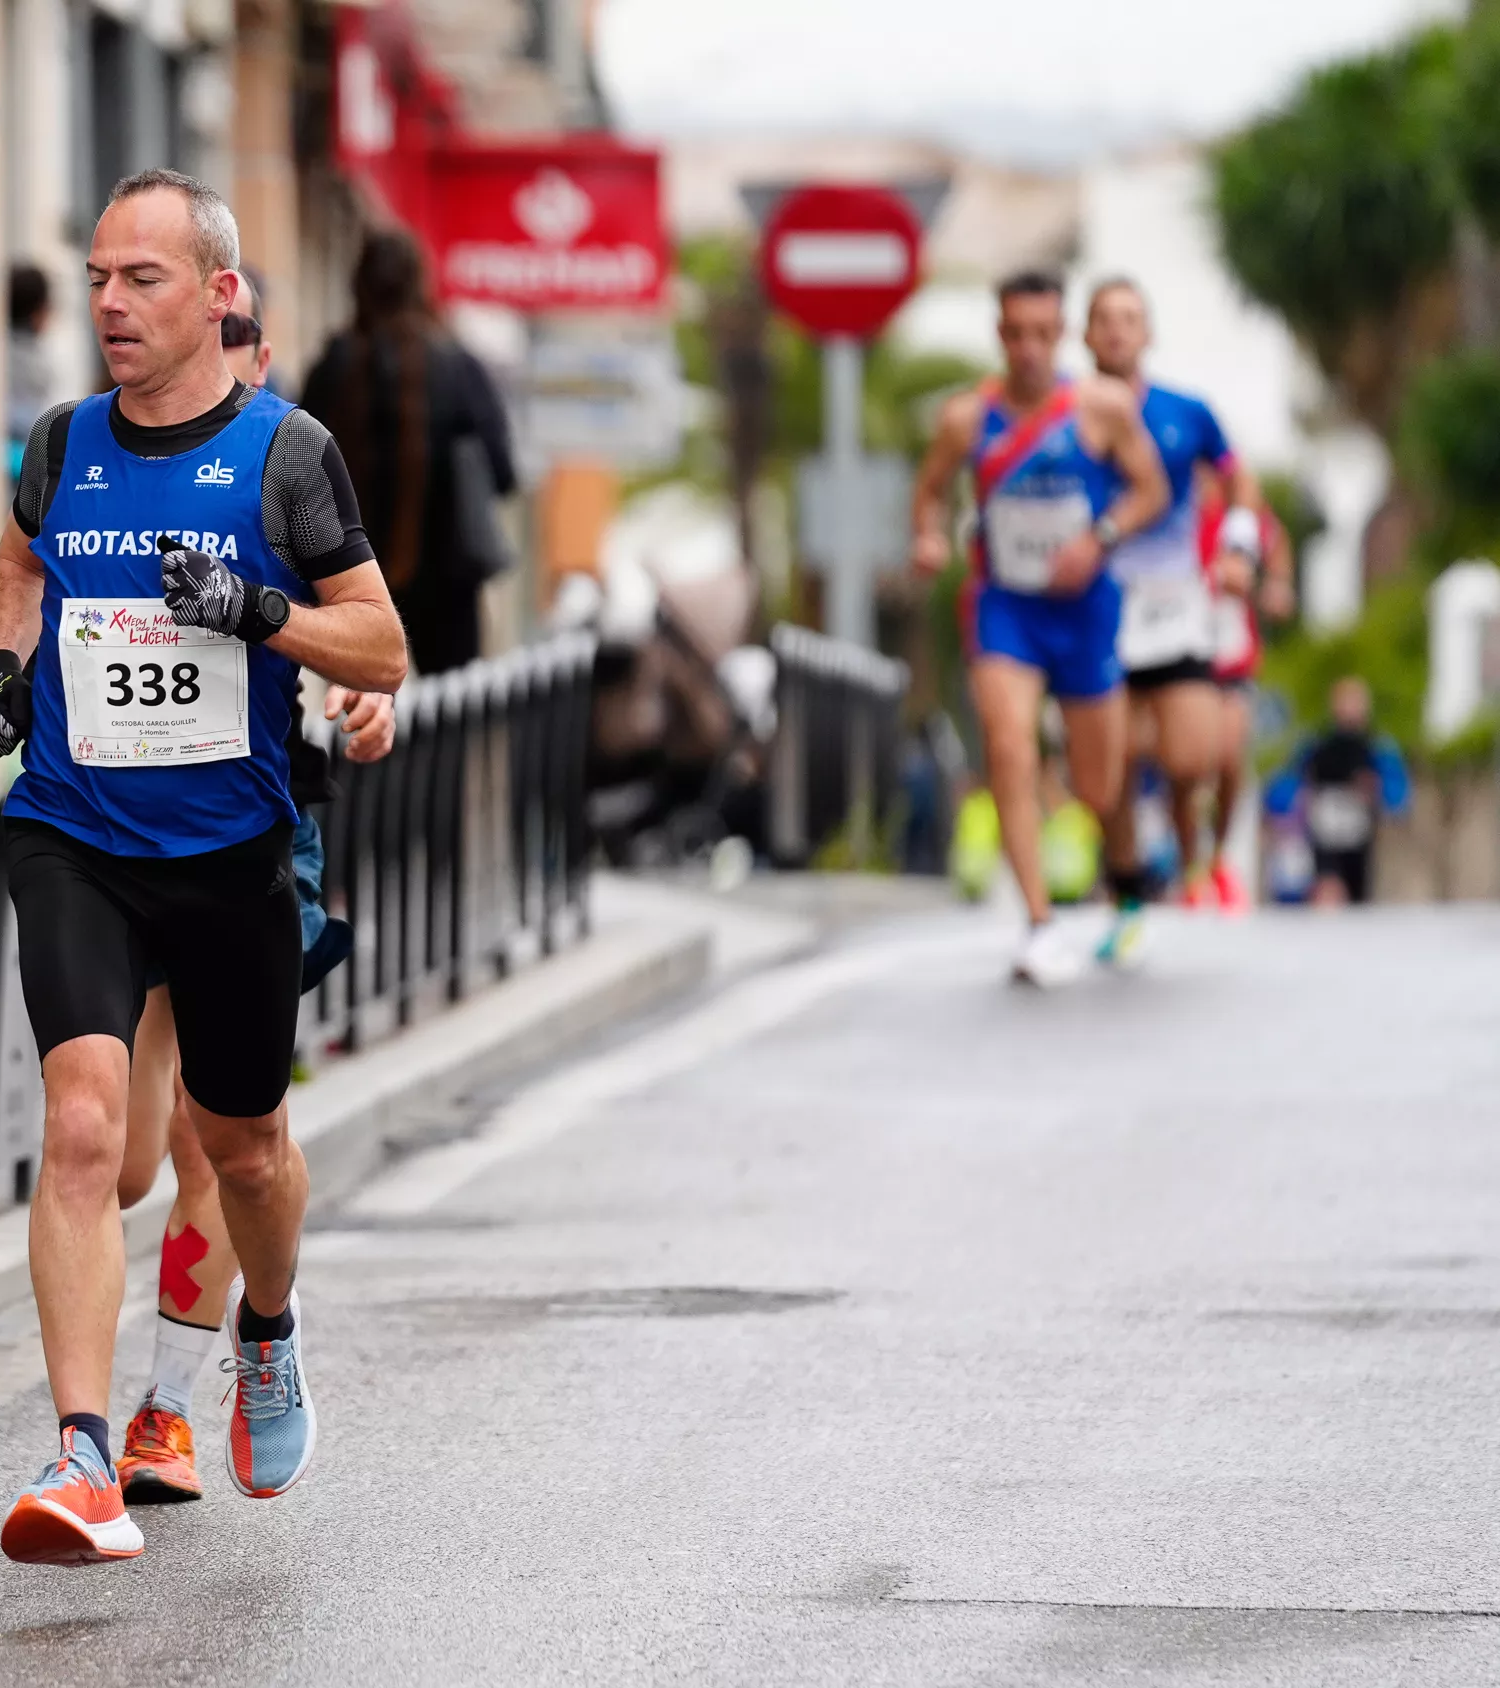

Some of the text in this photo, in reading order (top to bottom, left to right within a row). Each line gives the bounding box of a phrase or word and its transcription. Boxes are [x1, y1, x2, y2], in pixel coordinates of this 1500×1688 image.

[194, 457, 235, 485] als
[129, 628, 188, 647] LUCENA
[106, 662, 201, 707] 338
[170, 718, 197, 727] GUILLEN
